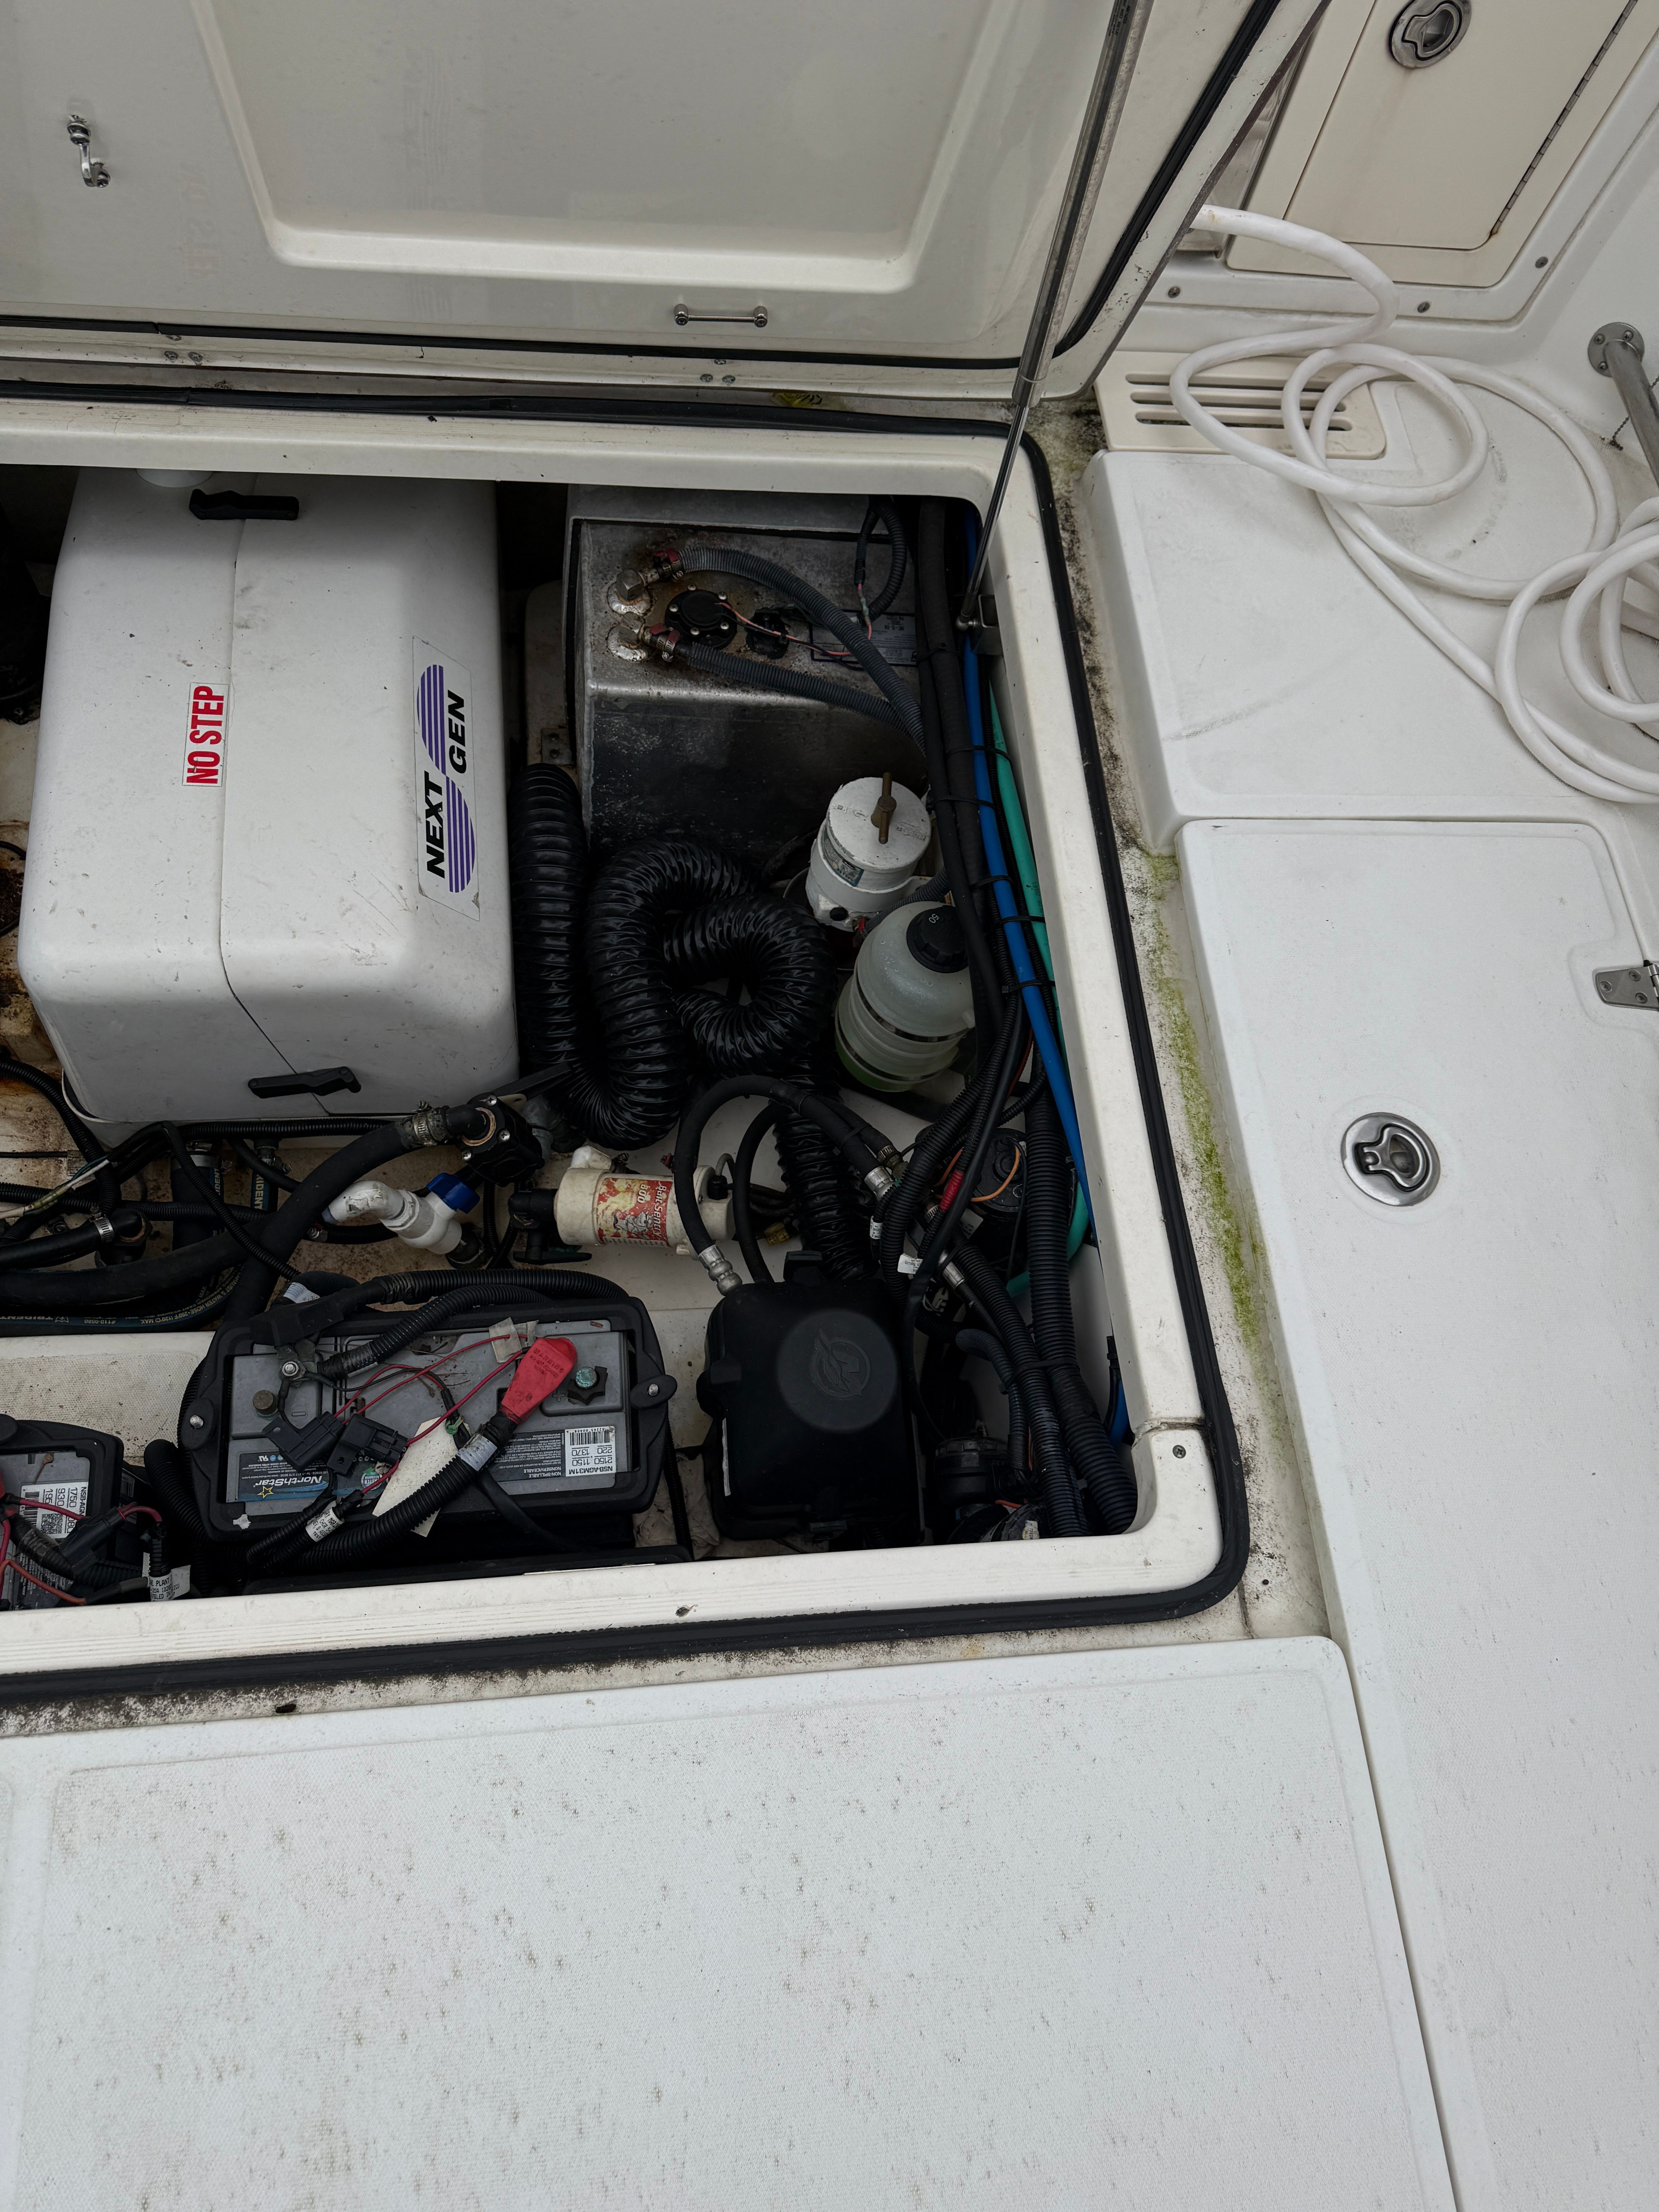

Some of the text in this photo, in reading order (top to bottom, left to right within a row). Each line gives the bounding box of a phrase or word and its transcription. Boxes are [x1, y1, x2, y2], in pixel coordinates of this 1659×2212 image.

[187, 686, 225, 784] NO STEP
[448, 690, 466, 773] GEN
[424, 771, 445, 878] NEXT
[928, 913, 939, 924] 50
[254, 1174, 264, 1209] RIDENT
[637, 1184, 647, 1203] 800
[653, 1185, 667, 1237] Bait Sentry
[204, 1294, 222, 1307] WATER
[569, 1466, 613, 1474] NSB-AGM31M
[572, 1458, 590, 1466] 1150
[255, 1475, 322, 1486] NorthStar
[45, 1489, 53, 1504] 195
[57, 1488, 66, 1506] 930
[69, 1487, 78, 1507] 1750
[156, 1577, 169, 1586] PLANT
